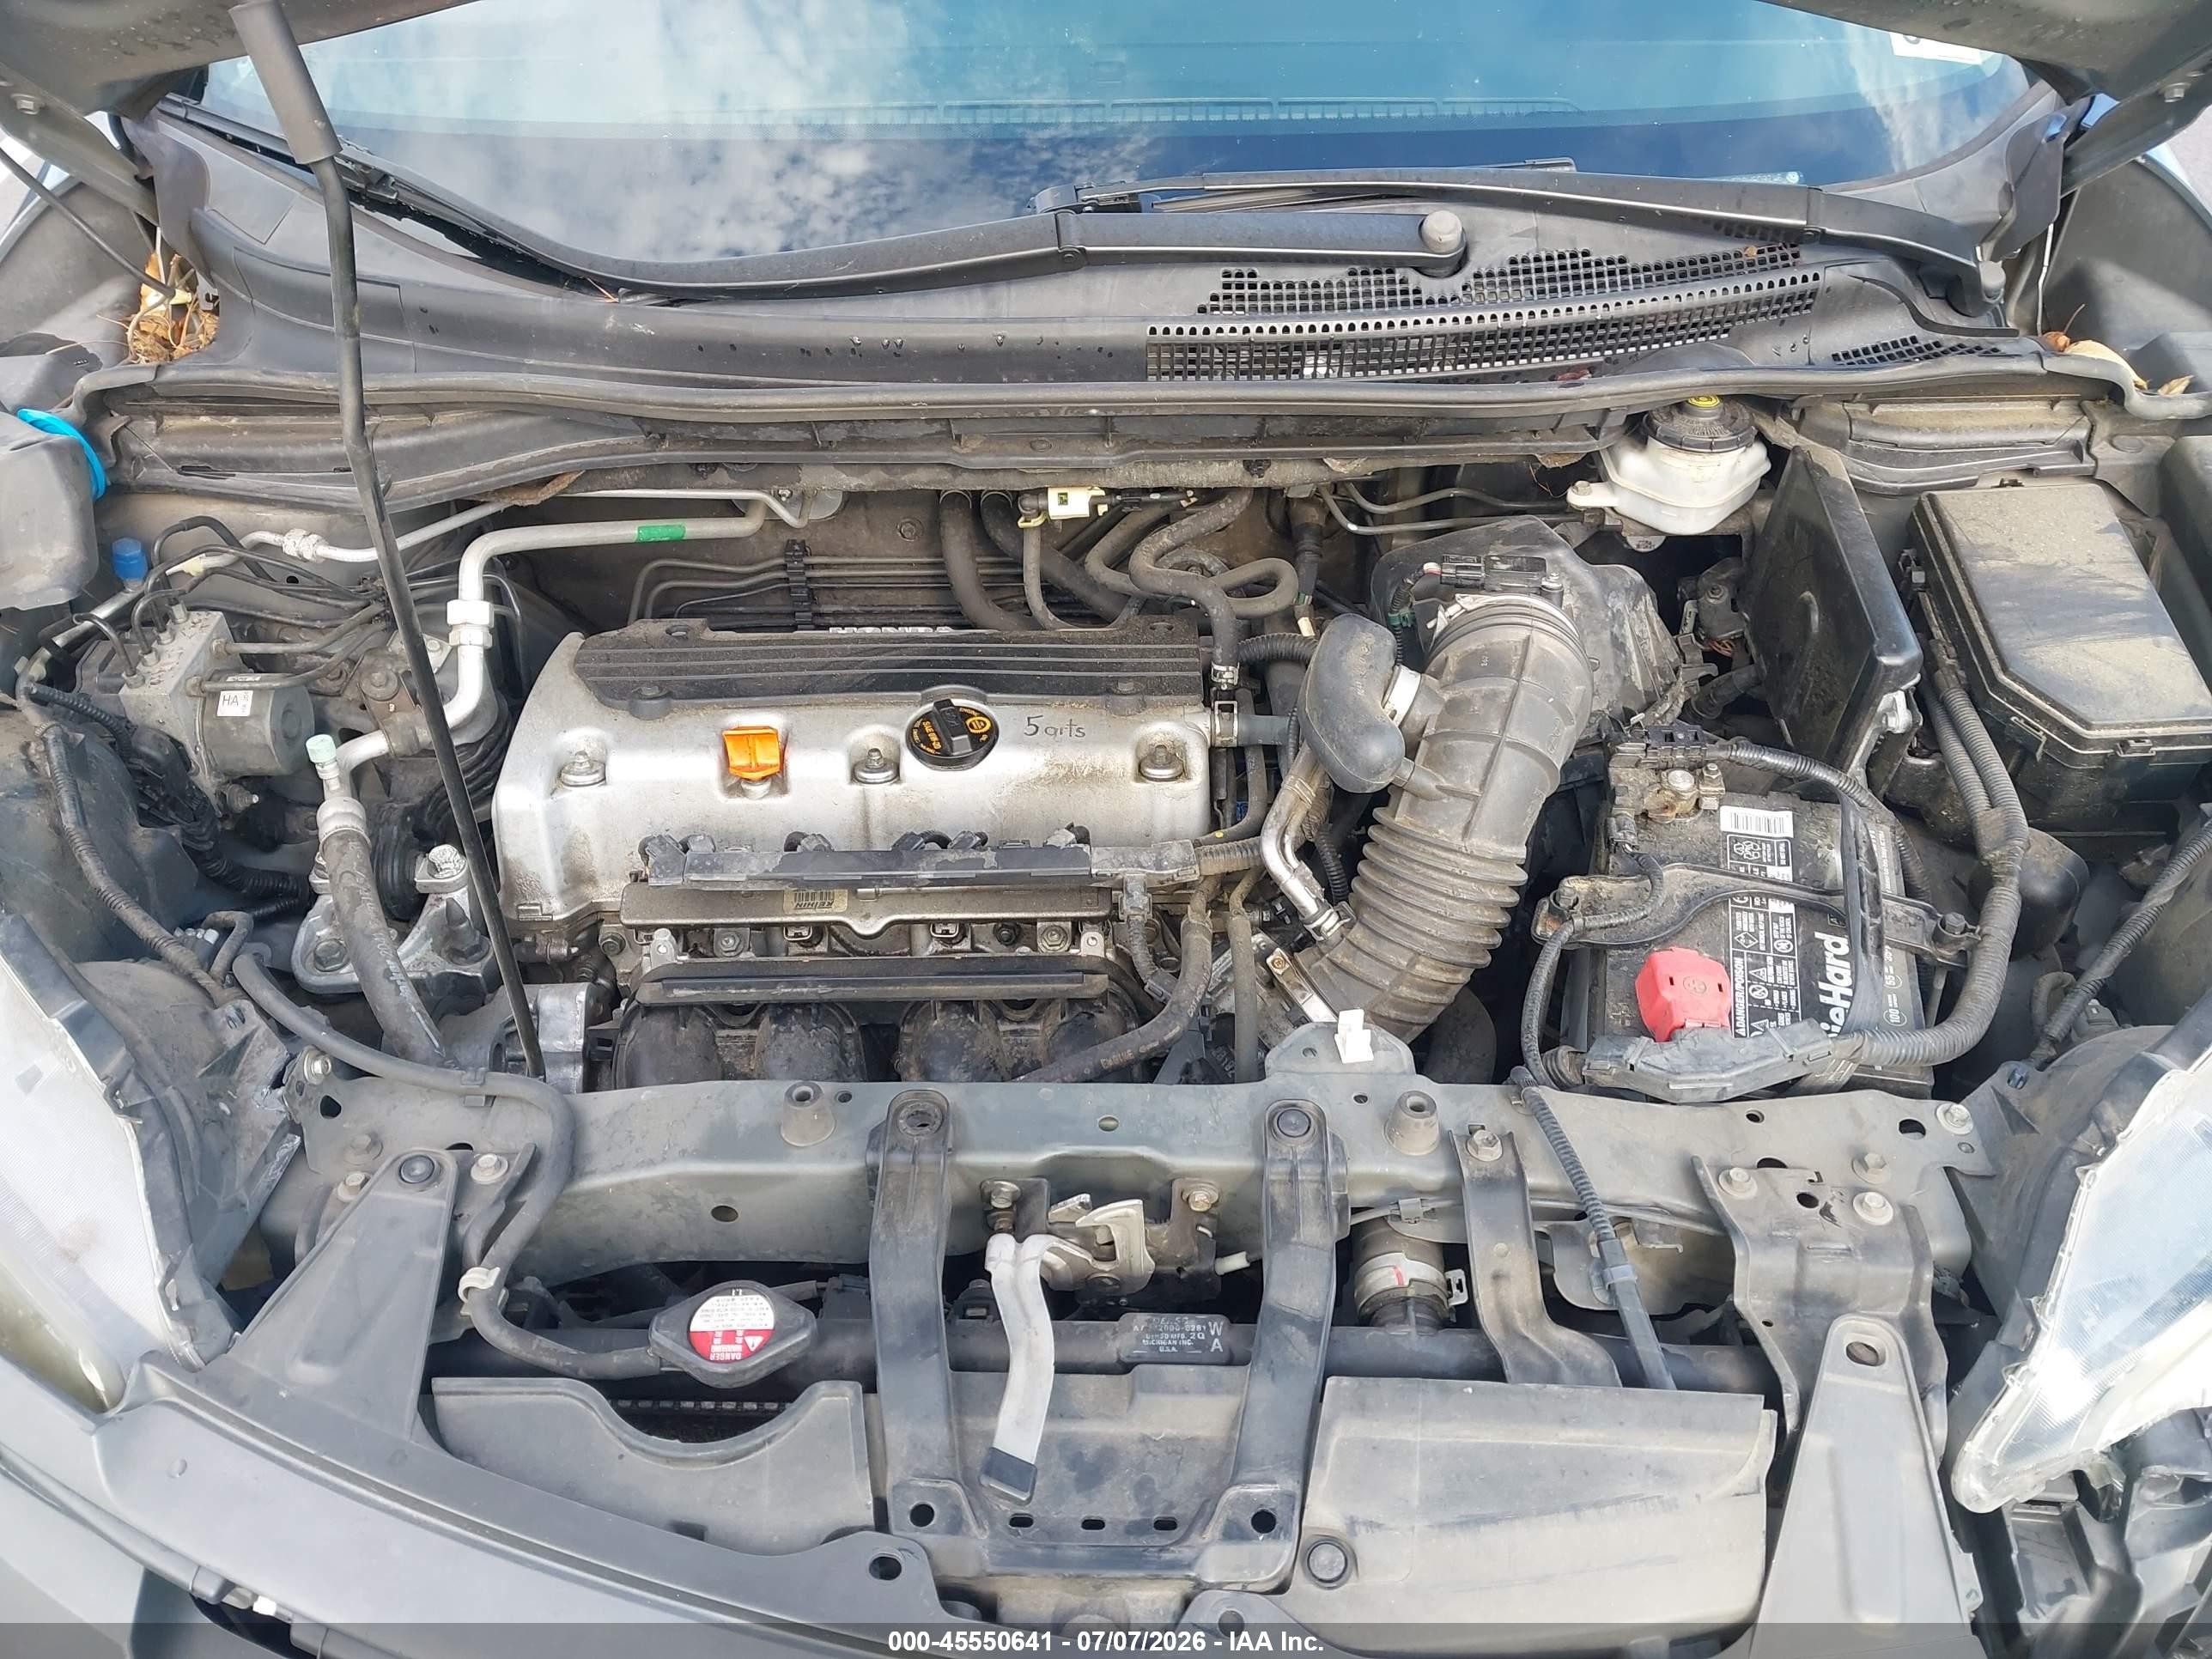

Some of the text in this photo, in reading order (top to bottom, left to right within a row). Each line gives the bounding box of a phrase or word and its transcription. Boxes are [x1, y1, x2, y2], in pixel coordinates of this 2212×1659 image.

[222, 694, 239, 708] HA
[1024, 714, 1044, 736] 5
[794, 900, 835, 910] KEIHIN
[1814, 932, 1853, 1037] ieHard
[1734, 957, 1746, 1028] DANGER/POISON
[1888, 1008, 1900, 1024] 100
[1208, 1321, 1224, 1336] W
[1210, 1337, 1224, 1352] A
[709, 1352, 742, 1361] DANGER
